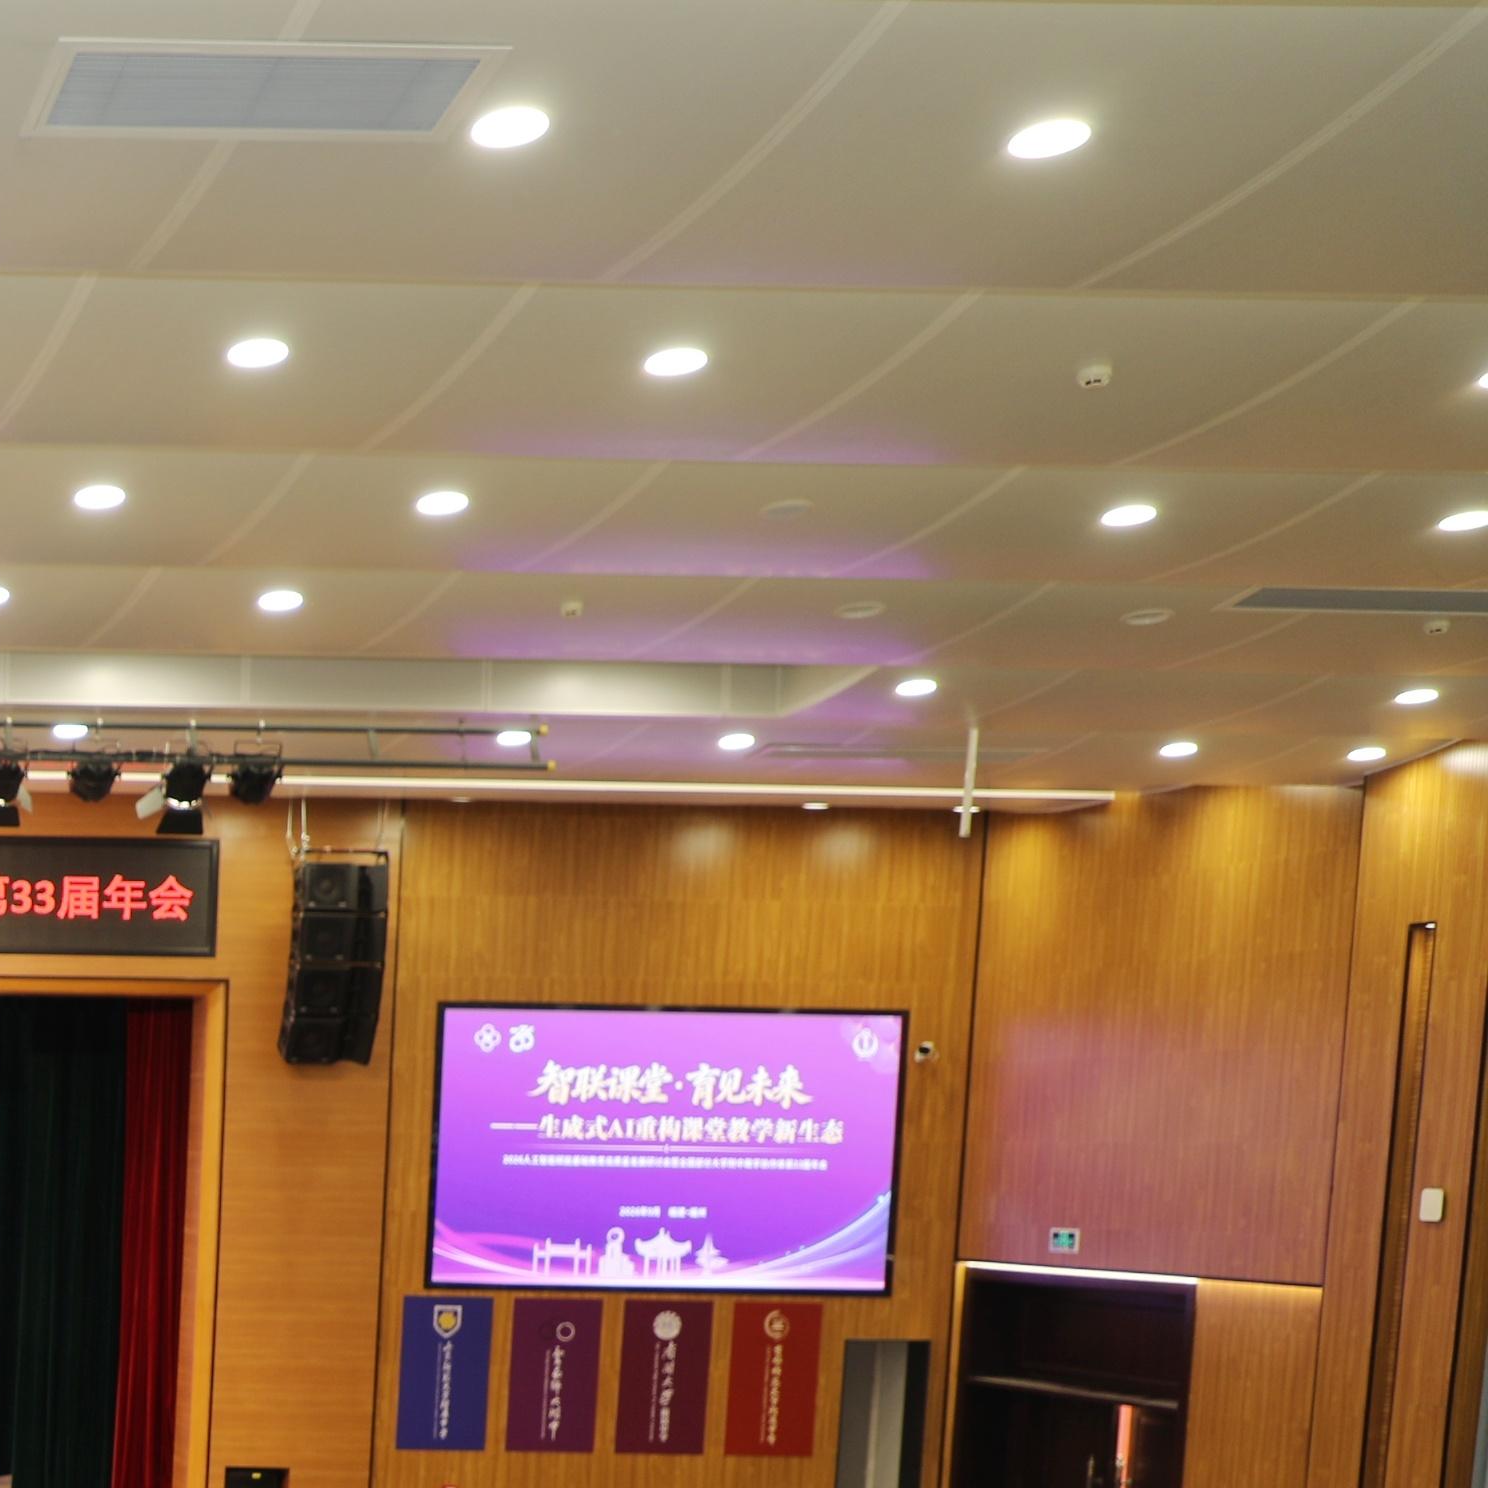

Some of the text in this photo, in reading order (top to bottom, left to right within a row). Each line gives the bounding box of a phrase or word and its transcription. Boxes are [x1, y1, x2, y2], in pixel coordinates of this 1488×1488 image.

[526, 1060, 814, 1110] 智联课堂·育见未来
